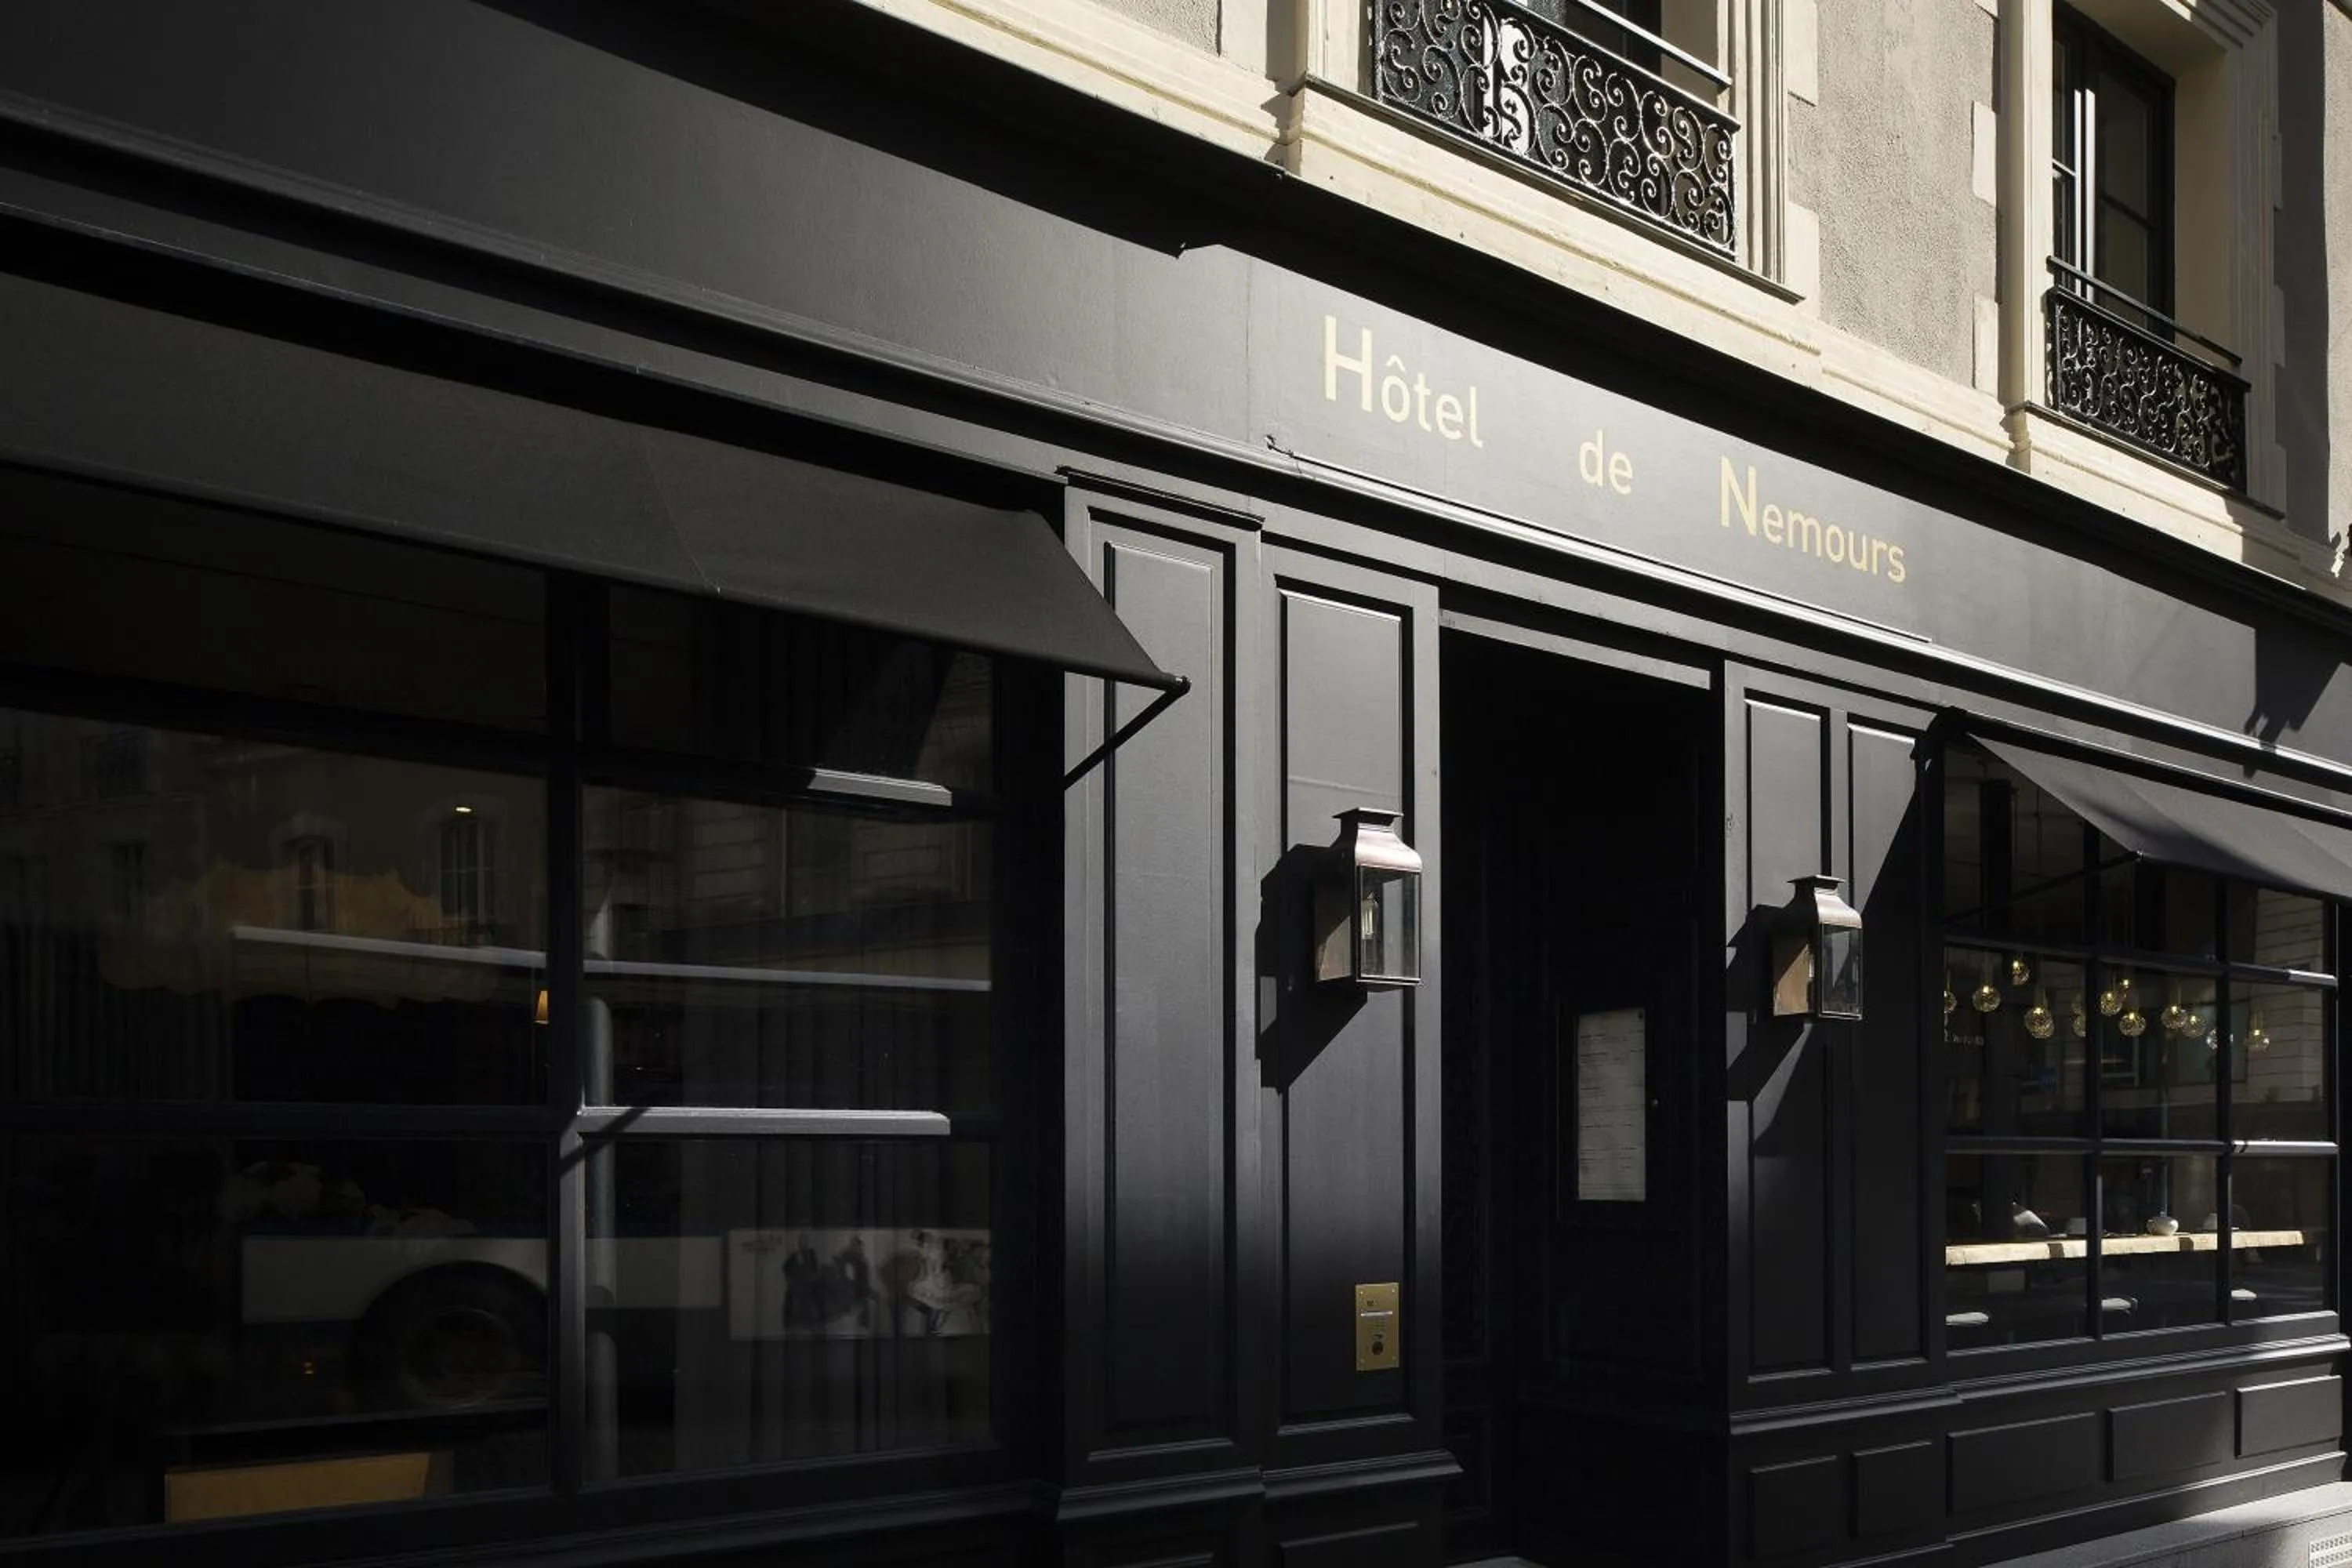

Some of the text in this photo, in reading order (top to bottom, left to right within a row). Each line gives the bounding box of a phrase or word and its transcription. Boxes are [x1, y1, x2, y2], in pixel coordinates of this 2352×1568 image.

[1325, 315, 1906, 583] Hôtel de Nemours
